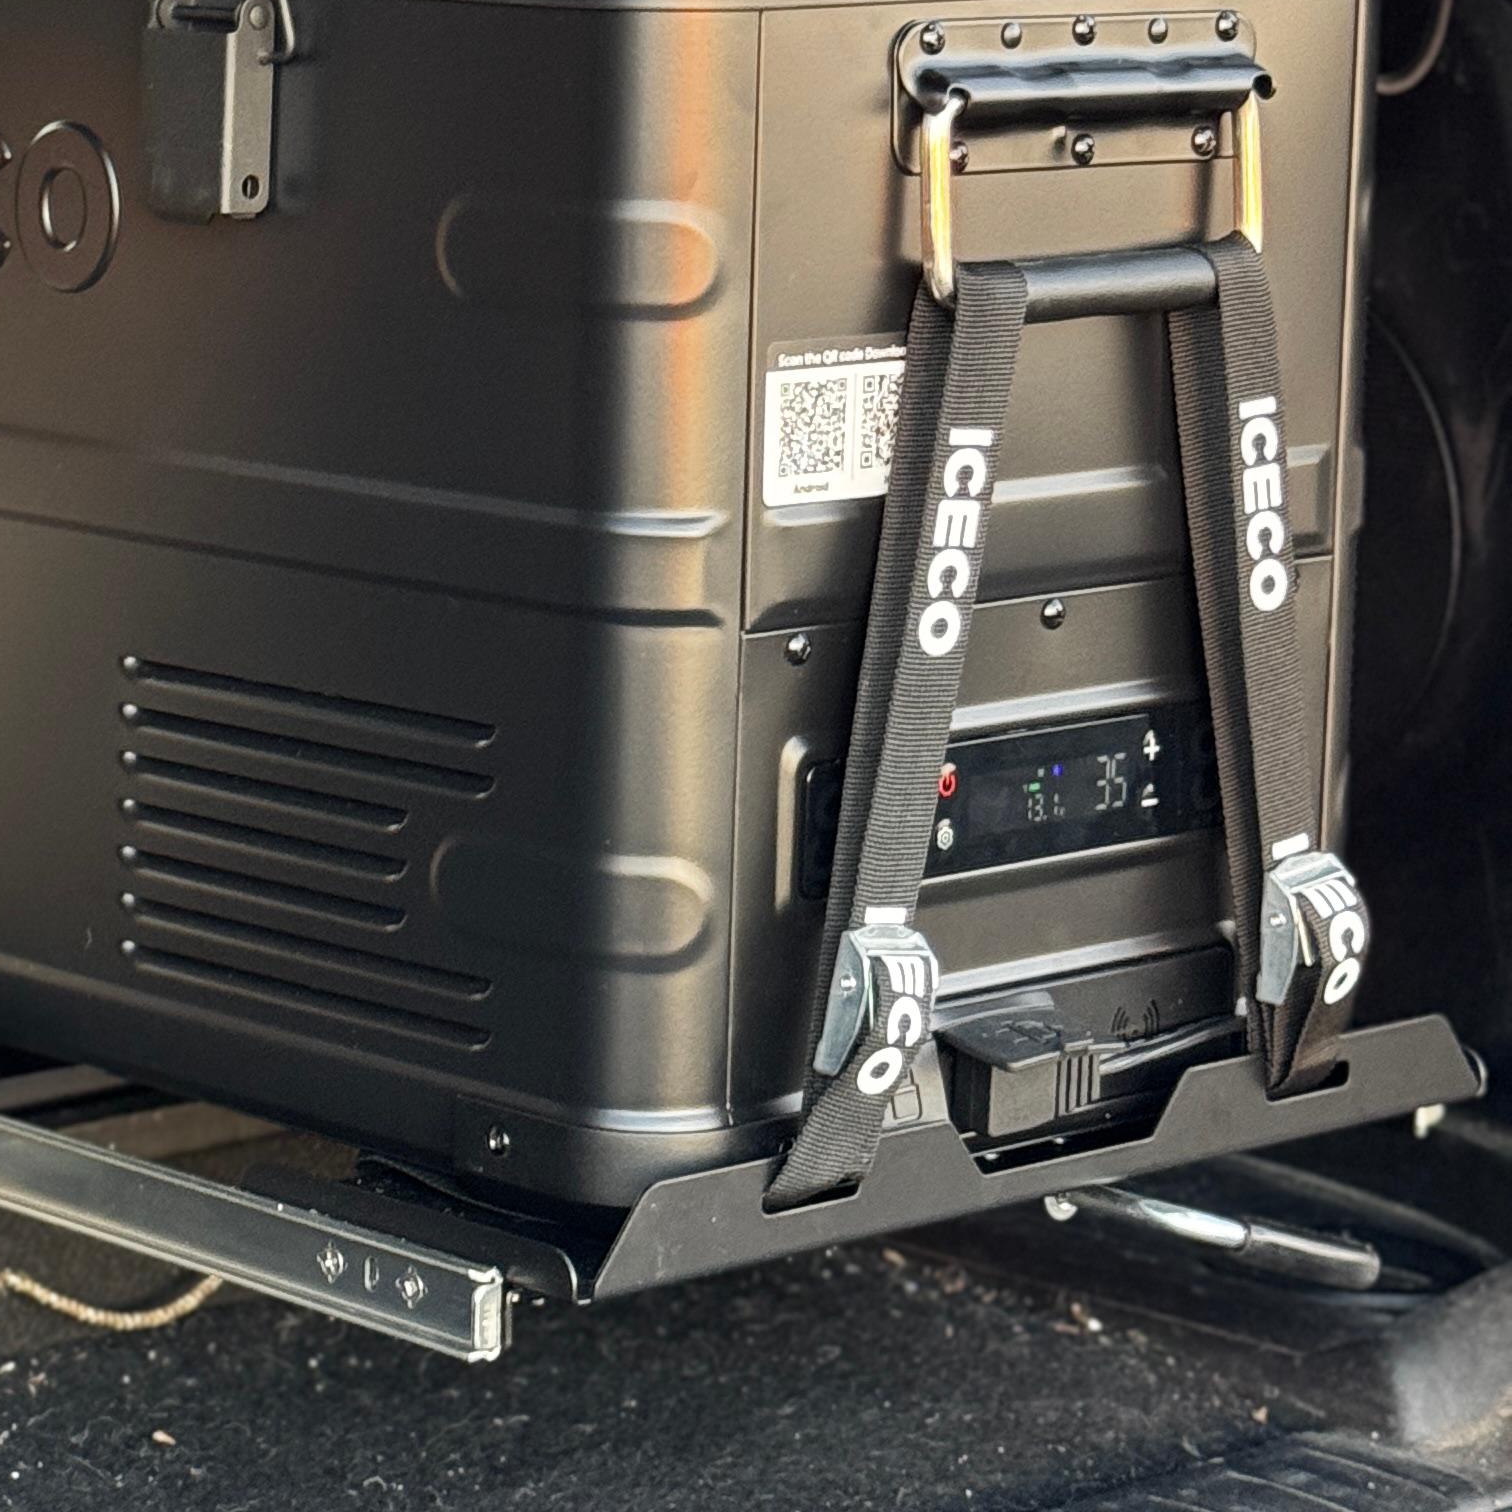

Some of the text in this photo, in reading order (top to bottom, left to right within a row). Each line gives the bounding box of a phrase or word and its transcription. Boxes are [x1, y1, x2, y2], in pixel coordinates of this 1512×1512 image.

[778, 353, 803, 368] Scan
[804, 350, 822, 365] the
[822, 348, 838, 364] QR
[865, 344, 906, 360] Downlo
[918, 428, 994, 657] ICECO
[1238, 396, 1290, 612] ICECO
[1094, 752, 1128, 811] 35
[856, 906, 926, 1096] IECO
[1272, 832, 1366, 1006] IECO
